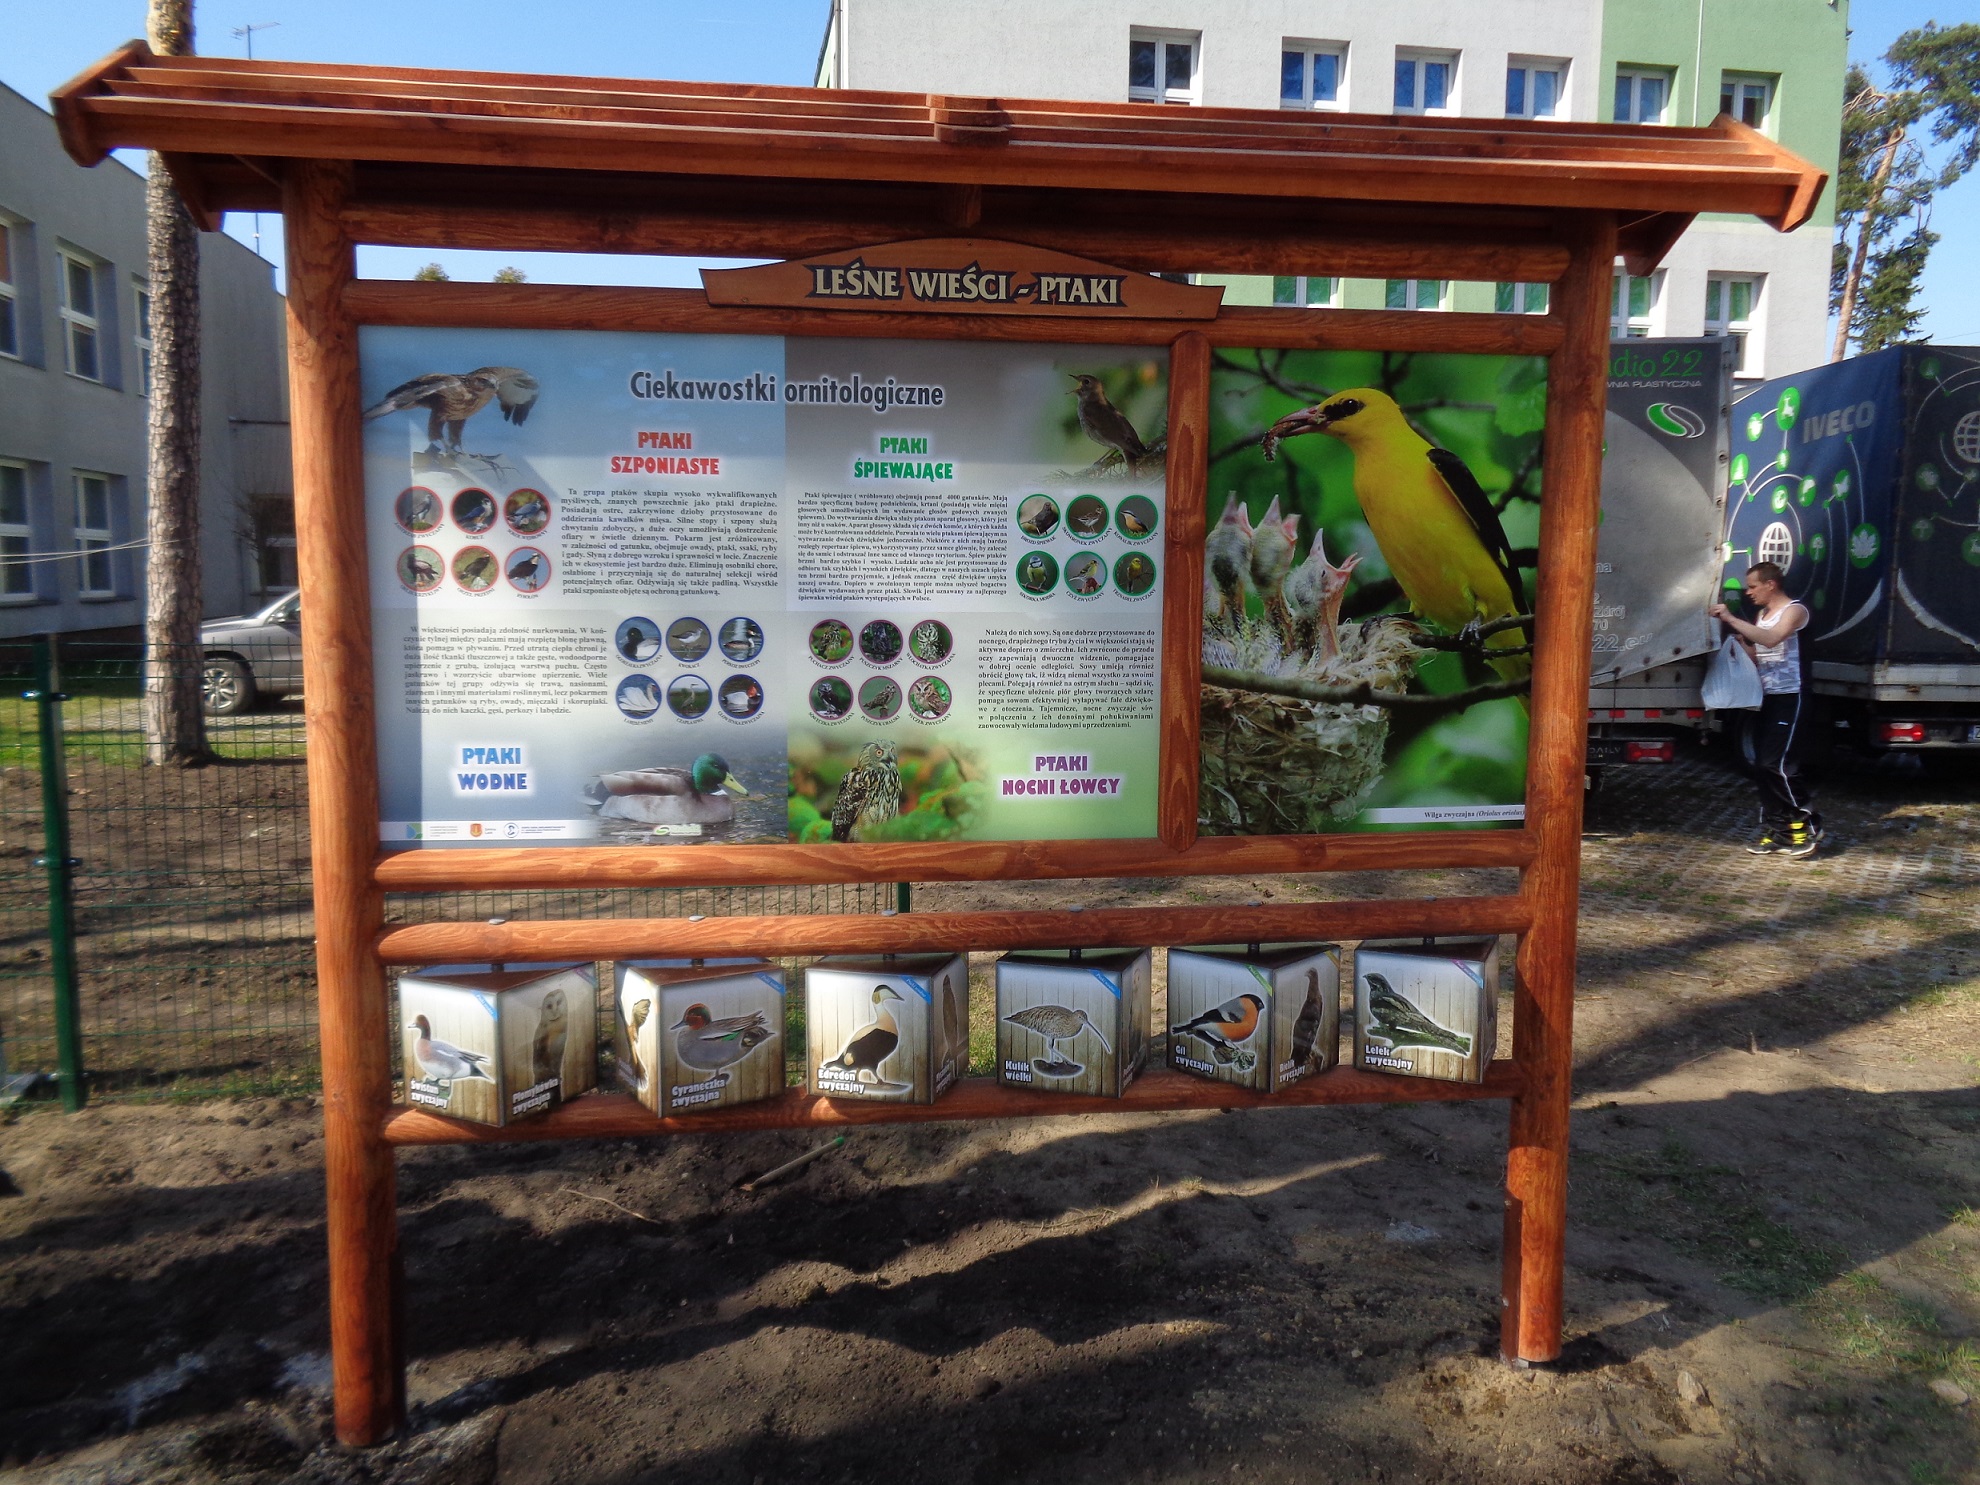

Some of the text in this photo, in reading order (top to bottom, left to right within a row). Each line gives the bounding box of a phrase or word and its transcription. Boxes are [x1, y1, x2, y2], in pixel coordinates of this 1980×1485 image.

[816, 263, 900, 297] LEŚNE
[909, 267, 1007, 300] WIEŚCI
[1040, 276, 1118, 304] PTAKI
[1661, 349, 1703, 377] 22
[630, 371, 944, 412] Ciekawostki ornitologiczne
[1632, 380, 1703, 388] PLASTYCZNA
[1803, 400, 1875, 444] IVECO
[638, 432, 692, 449] PTAKI
[880, 437, 928, 454] PTAKI
[611, 456, 719, 475] SZPONIASTE
[854, 458, 953, 483] ŚPIEWAJĄCE
[611, 489, 638, 498] ptaków
[644, 489, 668, 499] skupia
[674, 490, 701, 499] wysoko
[706, 490, 777, 500] wykwalifikowanych
[607, 498, 638, 507] znanych
[643, 498, 689, 508] powszechnie
[694, 498, 710, 508] jako
[716, 499, 735, 509] ptaki
[561, 506, 597, 516] Posiadają
[628, 507, 675, 517] zakrzywione
[680, 508, 704, 517] dzioby
[710, 508, 763, 518] przystosowane
[561, 524, 599, 534] chwytaniu
[689, 526, 731, 535] umożliwiają
[699, 517, 718, 526] stopy
[759, 518, 777, 527] służą
[561, 533, 584, 543] ofiary
[709, 534, 722, 544] jest
[462, 748, 521, 764] PTAKI
[1035, 756, 1088, 772] PTAKI
[457, 773, 527, 790] WODNE
[1003, 778, 1120, 795] NOCNI ŁOWCY
[1444, 810, 1475, 819] zwyczajna
[1175, 1045, 1186, 1056] Gil
[1365, 1044, 1390, 1056] Lelek
[1005, 1060, 1030, 1072] Kulik
[1175, 1055, 1214, 1074] zwyczajny
[1365, 1056, 1413, 1070] zwyczajny
[818, 1068, 856, 1081] Edredon
[1005, 1071, 1032, 1083] wielki
[672, 1079, 725, 1097] Cyraneczka
[818, 1080, 865, 1095] zwyczajny
[411, 1091, 448, 1109] zwyczajny
[671, 1091, 720, 1108] zwyczajna
